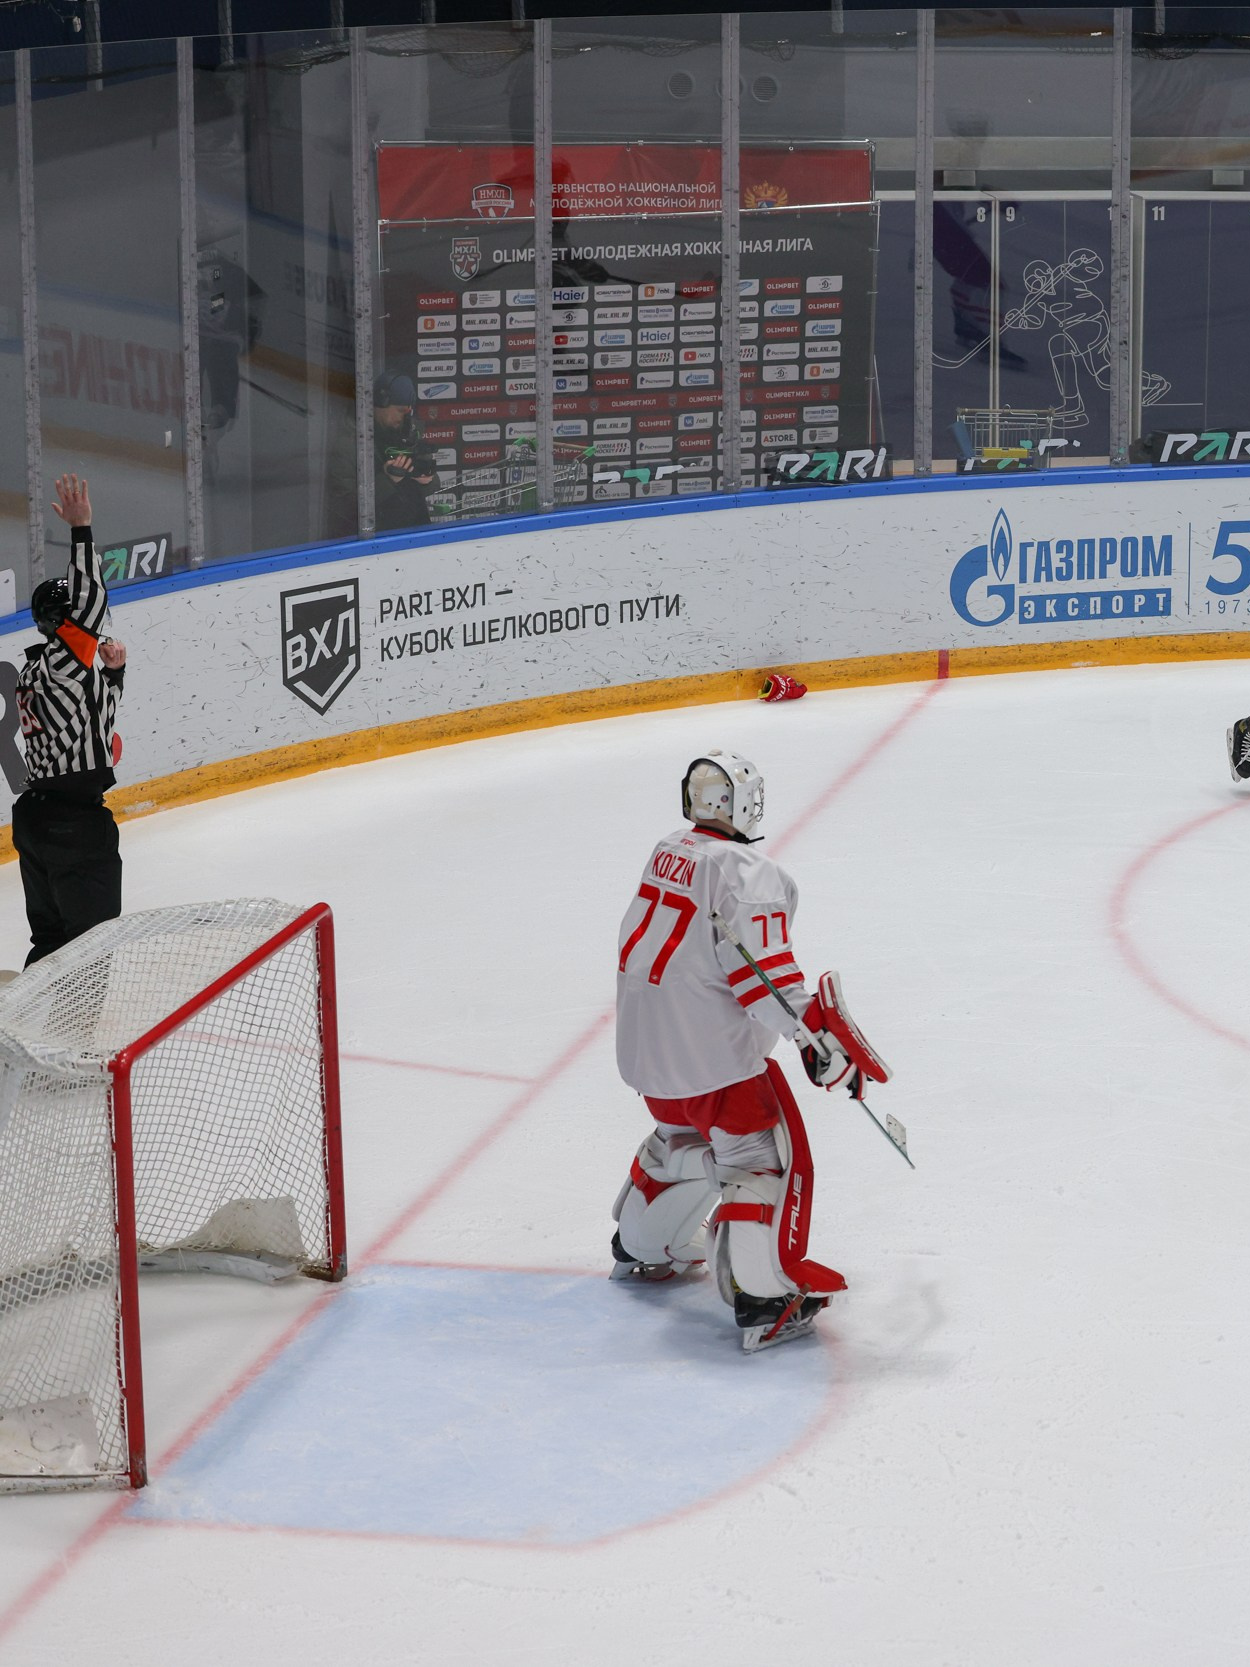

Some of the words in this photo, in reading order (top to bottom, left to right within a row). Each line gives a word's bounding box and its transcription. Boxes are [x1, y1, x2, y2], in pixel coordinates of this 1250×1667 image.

[480, 190, 505, 199] НМХЛ
[551, 183, 616, 195] ЕРВЕНСТВО
[618, 182, 716, 195] НАЦИОНАЛЬНОЙ
[626, 195, 696, 209] ХОККЕЙНОЙ
[976, 207, 986, 223] 8
[1006, 207, 1016, 222] 9
[1152, 206, 1165, 221] 11
[455, 246, 477, 254] МХЛ
[493, 247, 567, 263] OLIMPET
[571, 243, 681, 261] МОЛОДЕЖНАЯ
[684, 240, 772, 255] ХОККНАЯ
[776, 238, 813, 252] ЛИГА
[553, 290, 585, 300] Haier
[640, 331, 671, 341] Haier
[766, 326, 798, 334] OLIMPBET
[464, 385, 498, 393] OLIMPBET
[451, 408, 481, 416] OLIMPBET
[764, 412, 796, 420] OLIMPBET
[101, 538, 167, 582] ARI
[1018, 535, 1173, 584] ГАЗПРОМ
[379, 594, 433, 623] PARI
[442, 583, 486, 610] ВХЛ
[1023, 593, 1167, 621] ЭКСПОРТ
[380, 626, 454, 662] КУБОК
[463, 602, 609, 647] ШЕЛКОВОГО
[619, 593, 681, 624] ПУТИ
[286, 607, 356, 680] ВХЛ
[618, 883, 698, 986] 77
[751, 911, 788, 948] 77
[787, 1172, 803, 1251] TRUE
